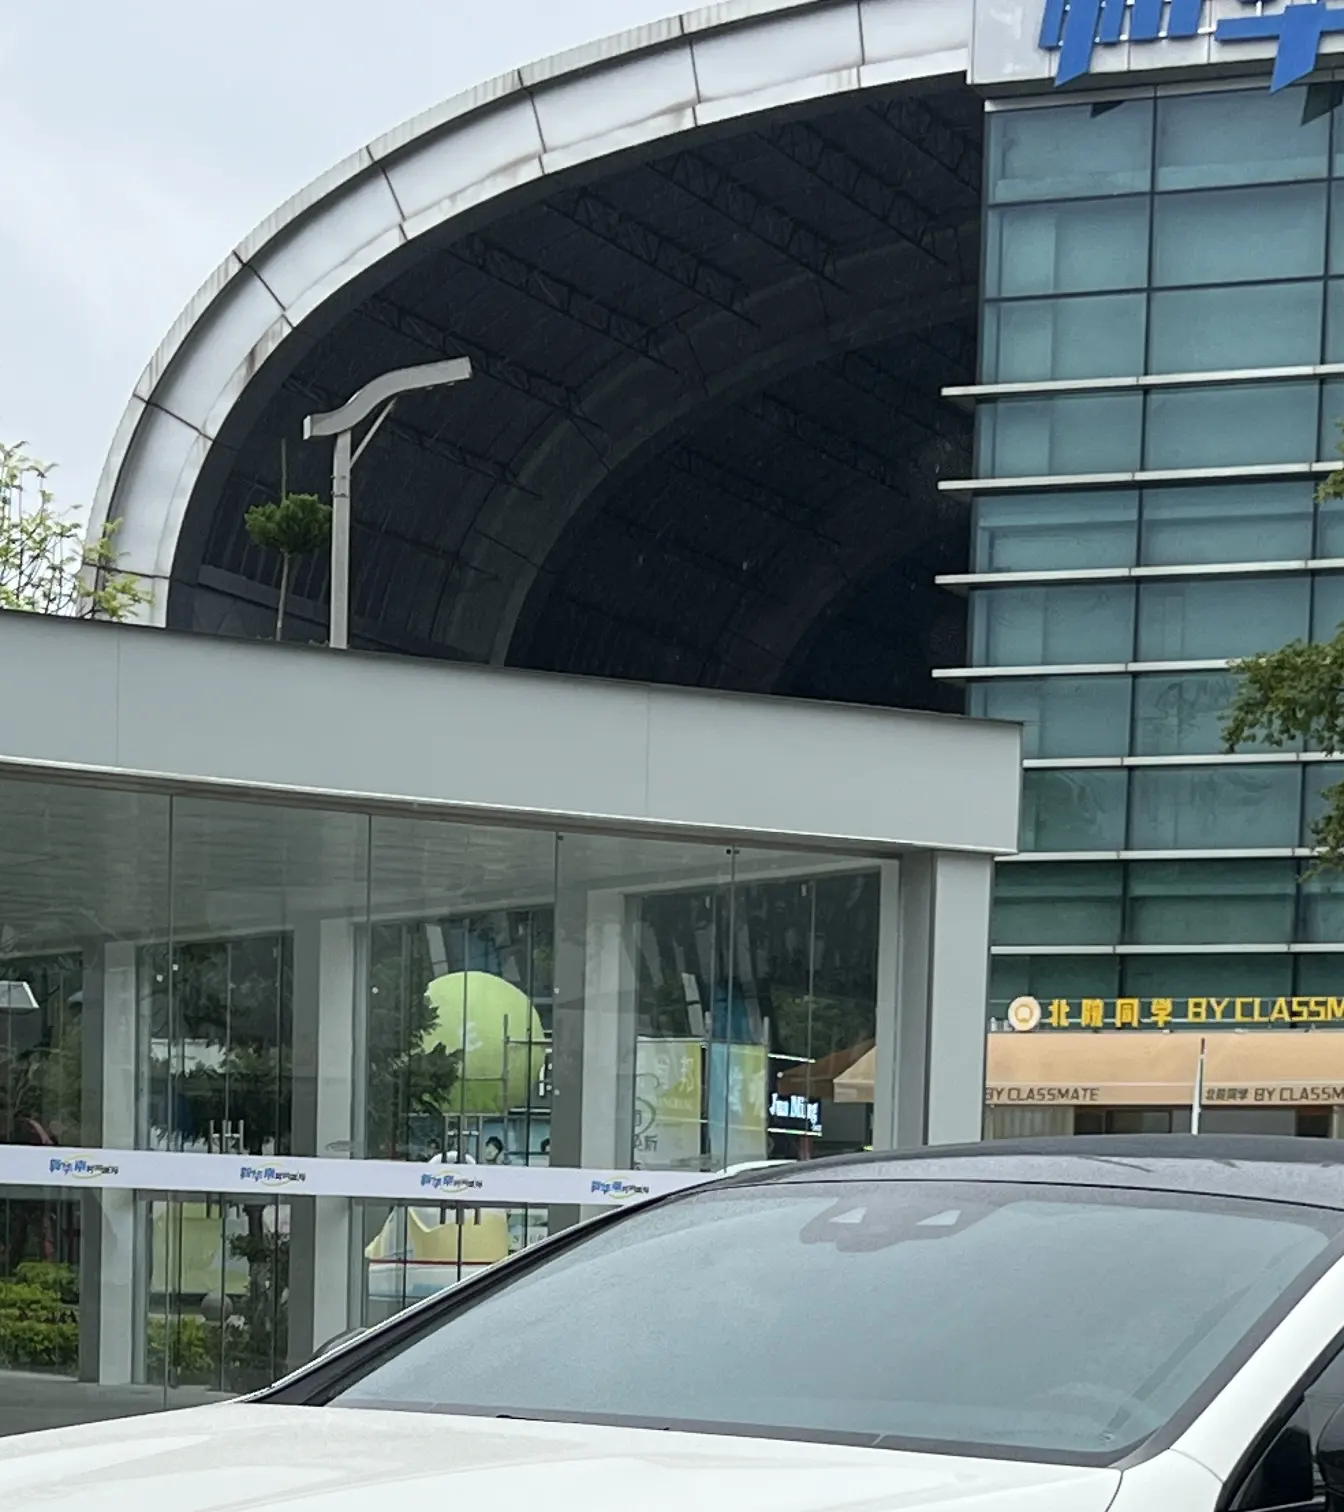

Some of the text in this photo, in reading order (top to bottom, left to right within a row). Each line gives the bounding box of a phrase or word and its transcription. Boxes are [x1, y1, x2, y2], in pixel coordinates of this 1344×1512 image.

[1187, 998, 1230, 1021] BY
[1008, 1087, 1100, 1101] CLASSMATE
[1254, 1088, 1275, 1101] BY
